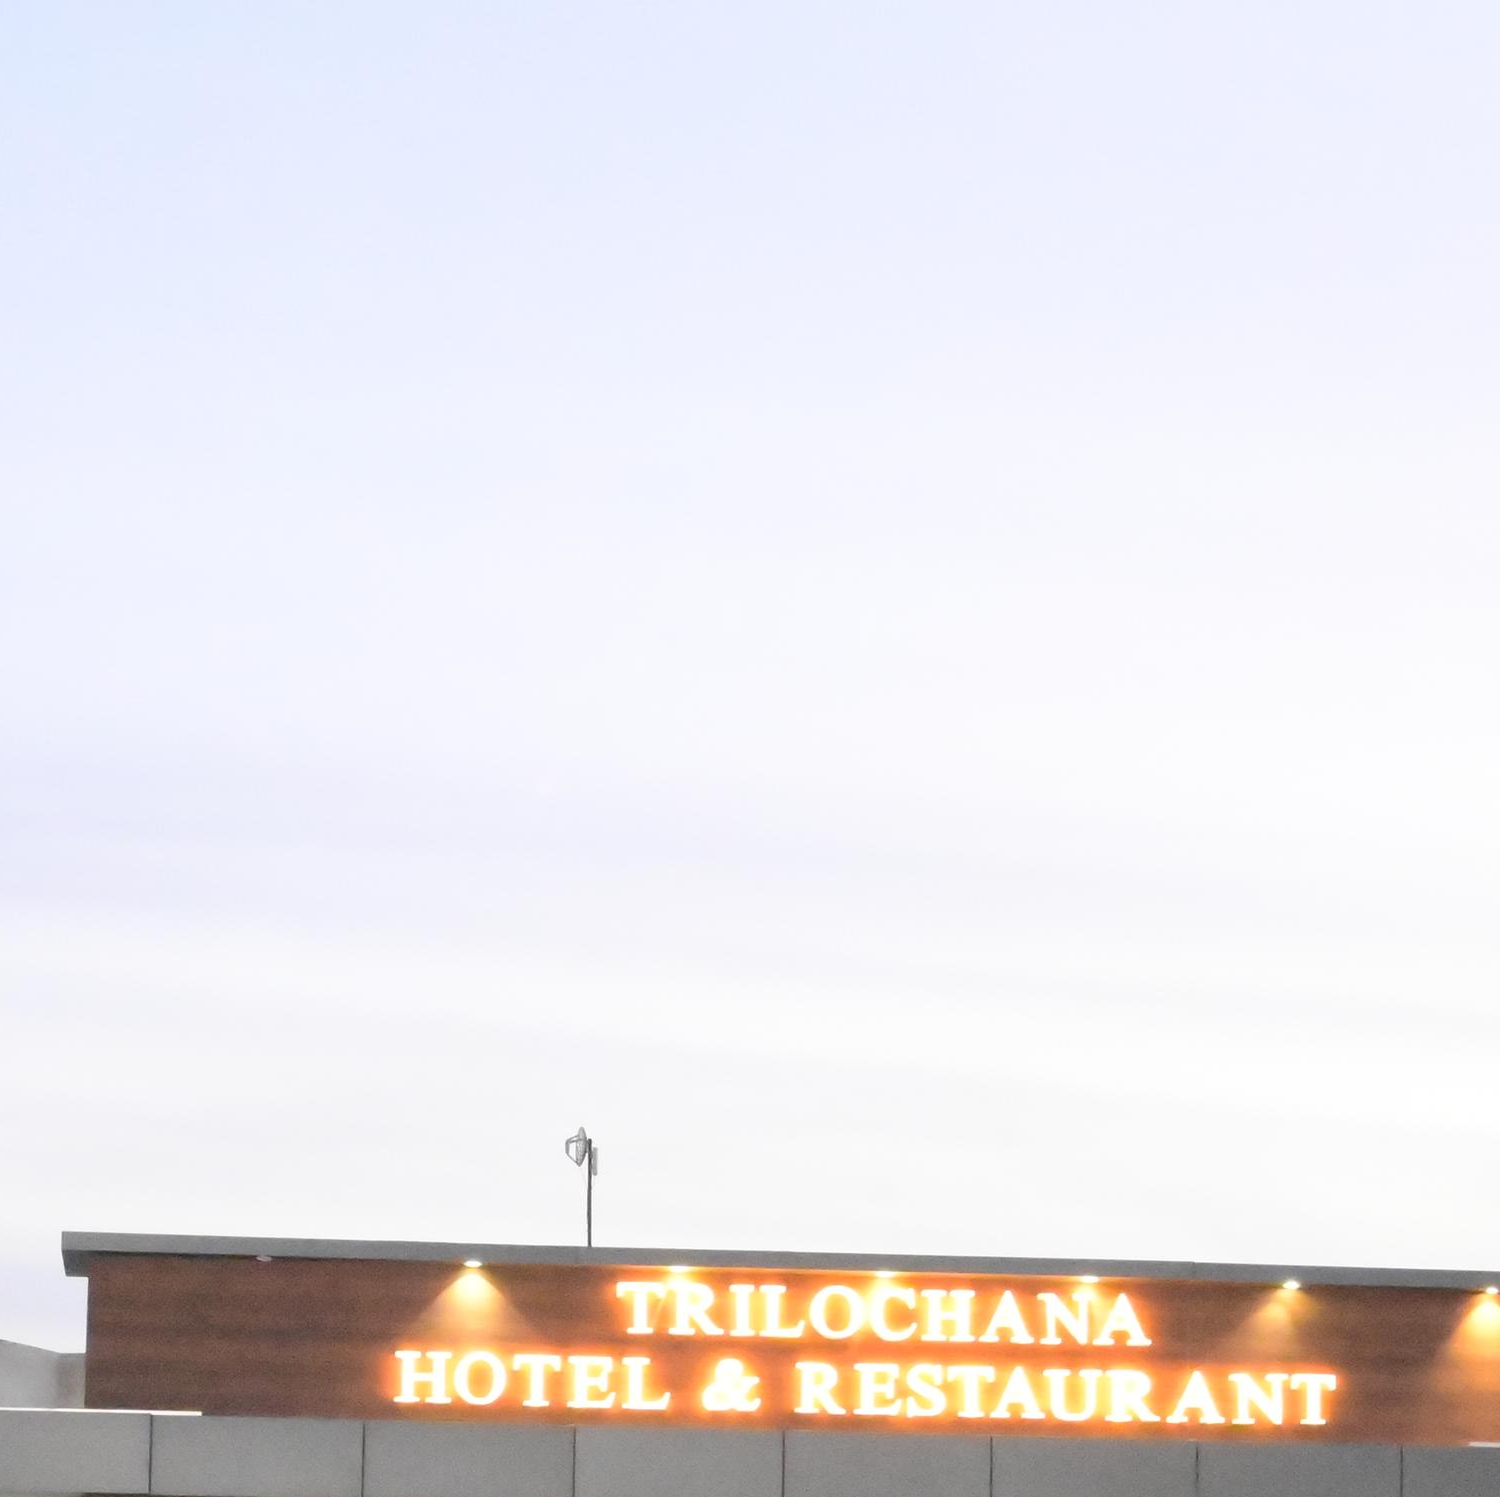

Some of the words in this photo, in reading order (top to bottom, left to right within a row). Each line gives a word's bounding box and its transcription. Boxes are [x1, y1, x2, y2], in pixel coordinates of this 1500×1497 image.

[614, 1280, 1153, 1347] TRILOCHANA
[393, 1349, 672, 1411] HOTEL
[700, 1356, 763, 1413] &
[793, 1360, 1338, 1426] RESTAURANT
